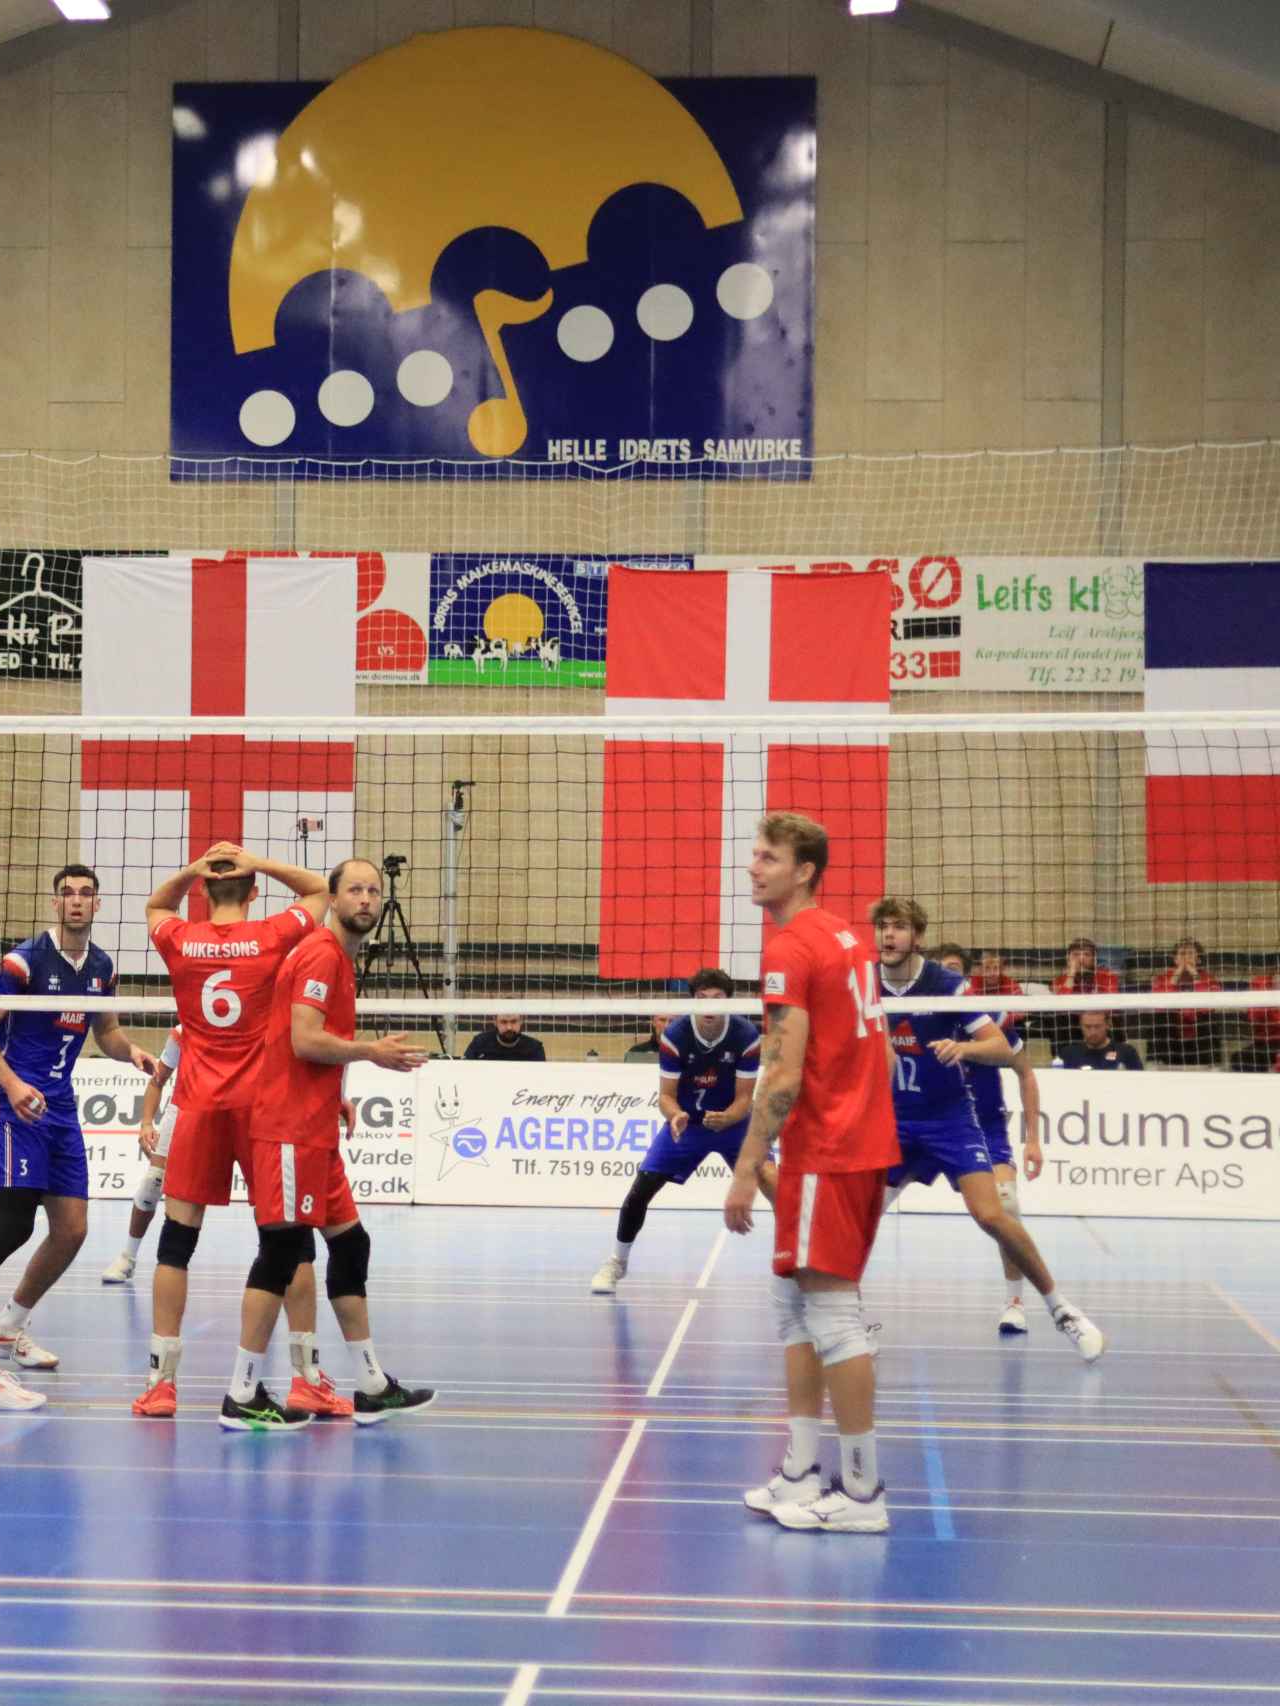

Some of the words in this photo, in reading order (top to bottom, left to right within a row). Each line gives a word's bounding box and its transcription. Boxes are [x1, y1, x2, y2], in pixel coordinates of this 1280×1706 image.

[548, 439, 607, 461] HELLE
[619, 439, 691, 461] IDRÆTS
[704, 439, 802, 461] SAMVIRKE
[975, 573, 1052, 612] Leifs
[433, 588, 459, 633] JØRNS
[1029, 666, 1056, 686] Tlf.
[1064, 667, 1085, 683] 22
[182, 940, 259, 959] MIKELSONS
[201, 969, 242, 1028] 6
[848, 960, 884, 1039] 14
[60, 1011, 85, 1024] MAIF
[52, 1035, 75, 1071] 3
[895, 1054, 922, 1093] 12
[399, 1097, 415, 1129] ApS
[511, 1088, 575, 1113] Energi
[580, 1091, 641, 1114] rigtige
[1005, 1099, 1191, 1148] ndum
[1203, 1113, 1280, 1151] sa
[19, 1159, 29, 1177] 3
[348, 1148, 413, 1166] Varde
[512, 1158, 541, 1175] Tlf.
[550, 1159, 595, 1176] 7519
[99, 1172, 125, 1189] 75
[1049, 1159, 1167, 1187] Tømrer
[1175, 1161, 1245, 1195] ApS
[300, 1194, 314, 1215] 8
